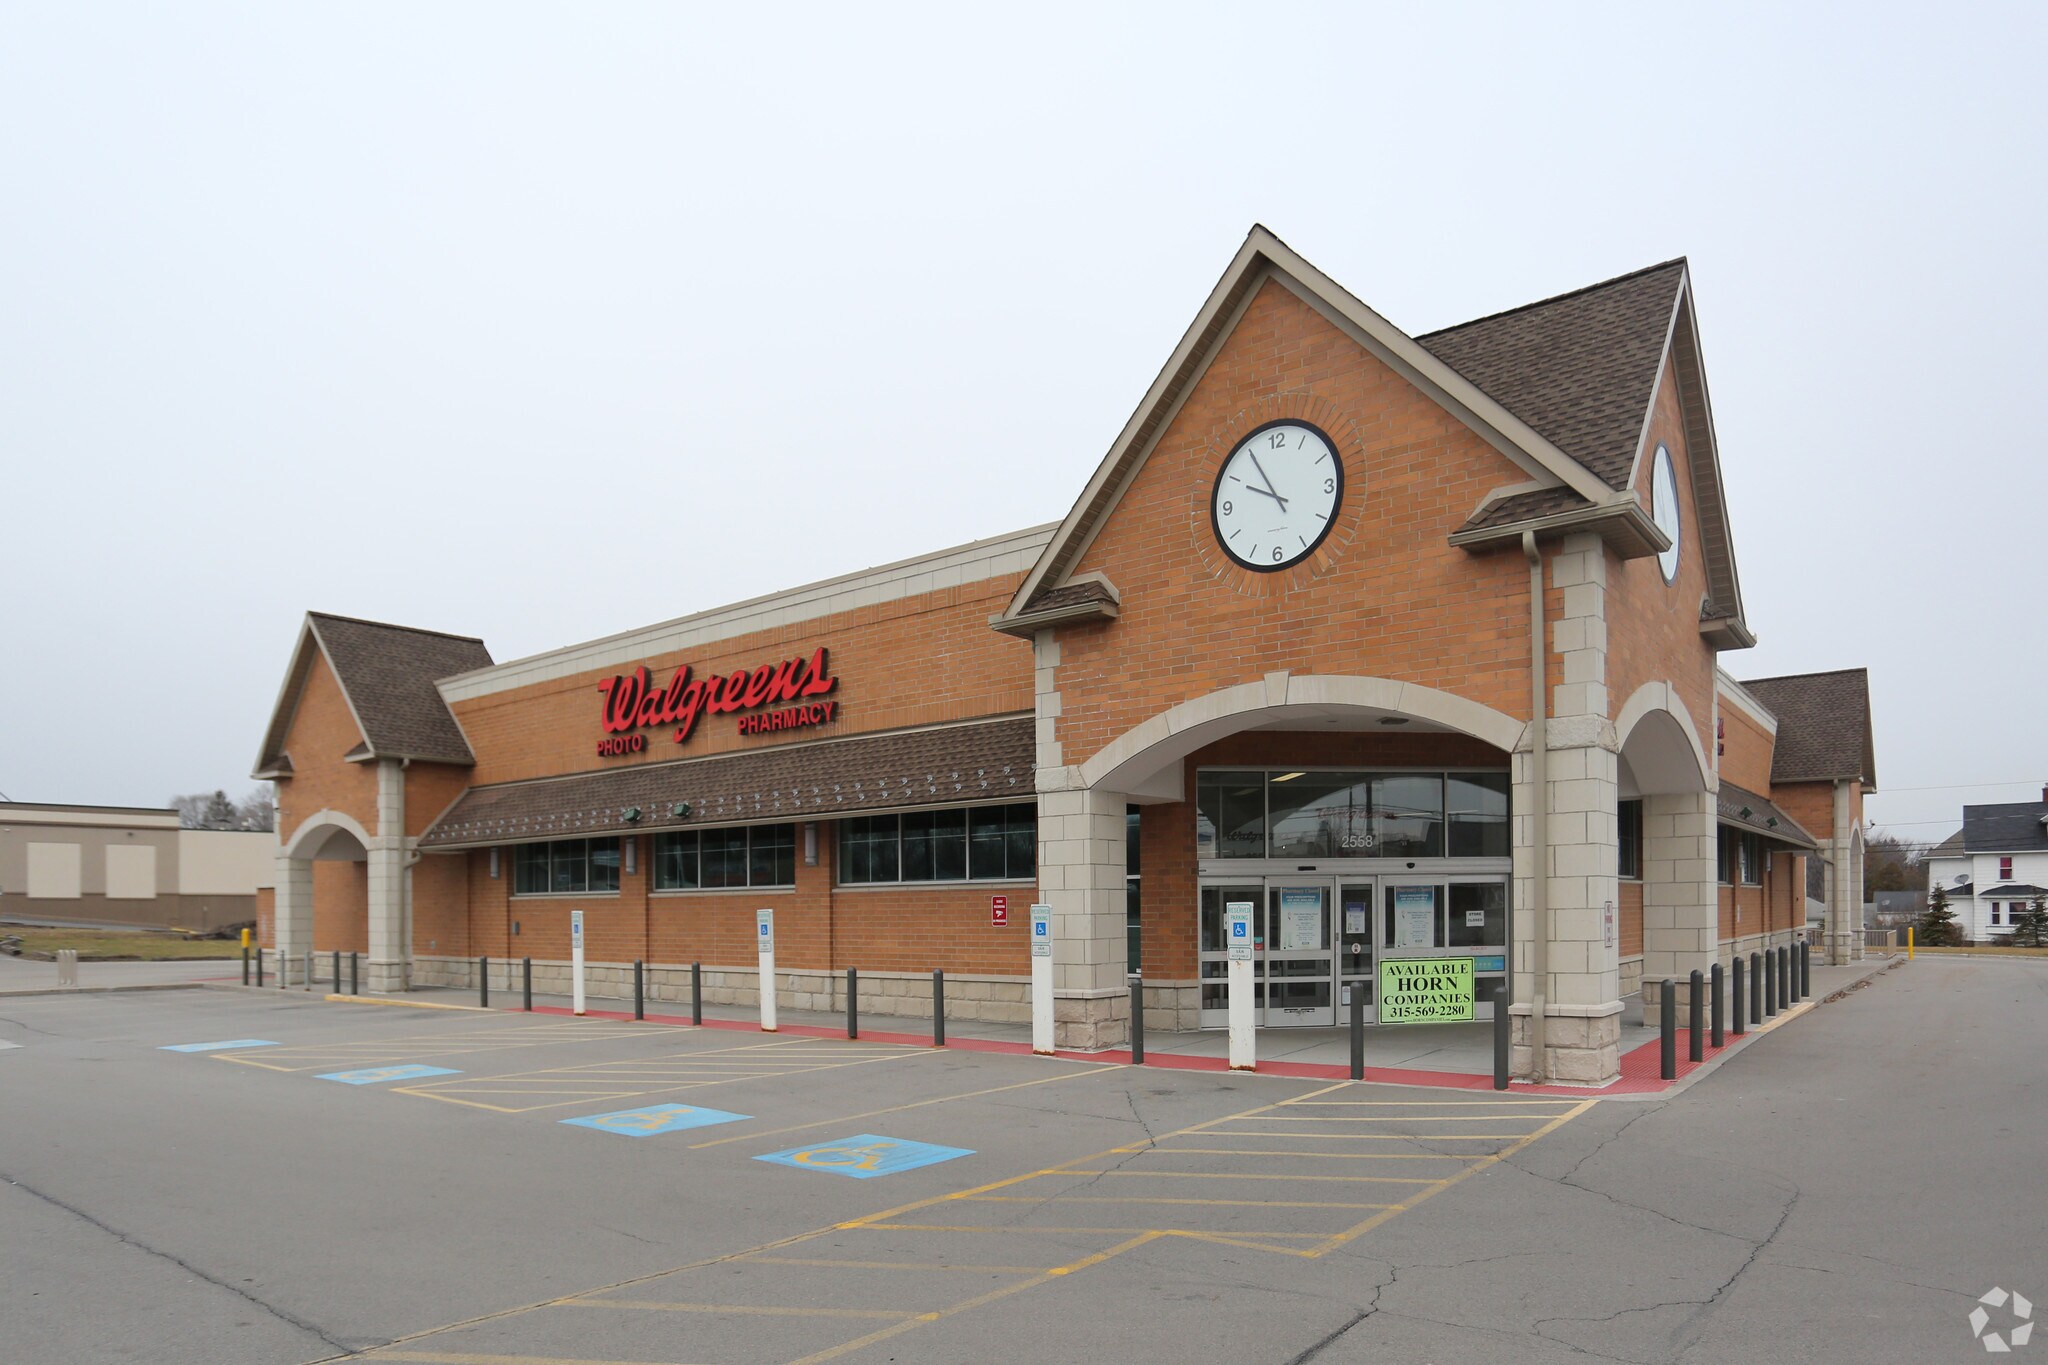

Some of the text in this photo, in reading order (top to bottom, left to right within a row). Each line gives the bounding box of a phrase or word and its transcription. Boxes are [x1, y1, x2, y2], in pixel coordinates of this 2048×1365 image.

[1268, 432, 1285, 449] 12
[1323, 478, 1335, 494] 3
[1222, 500, 1233, 516] 9
[1272, 546, 1283, 562] 6
[597, 646, 837, 744] Walgreens
[737, 700, 837, 735] PHARMACY
[597, 734, 645, 757] PHOTO
[1341, 835, 1373, 848] 2558
[1386, 963, 1469, 976] AVAILABLE
[1397, 976, 1458, 992] HORN
[1384, 993, 1471, 1006] COMPANIES
[1390, 1005, 1465, 1017] 315-569-2280
